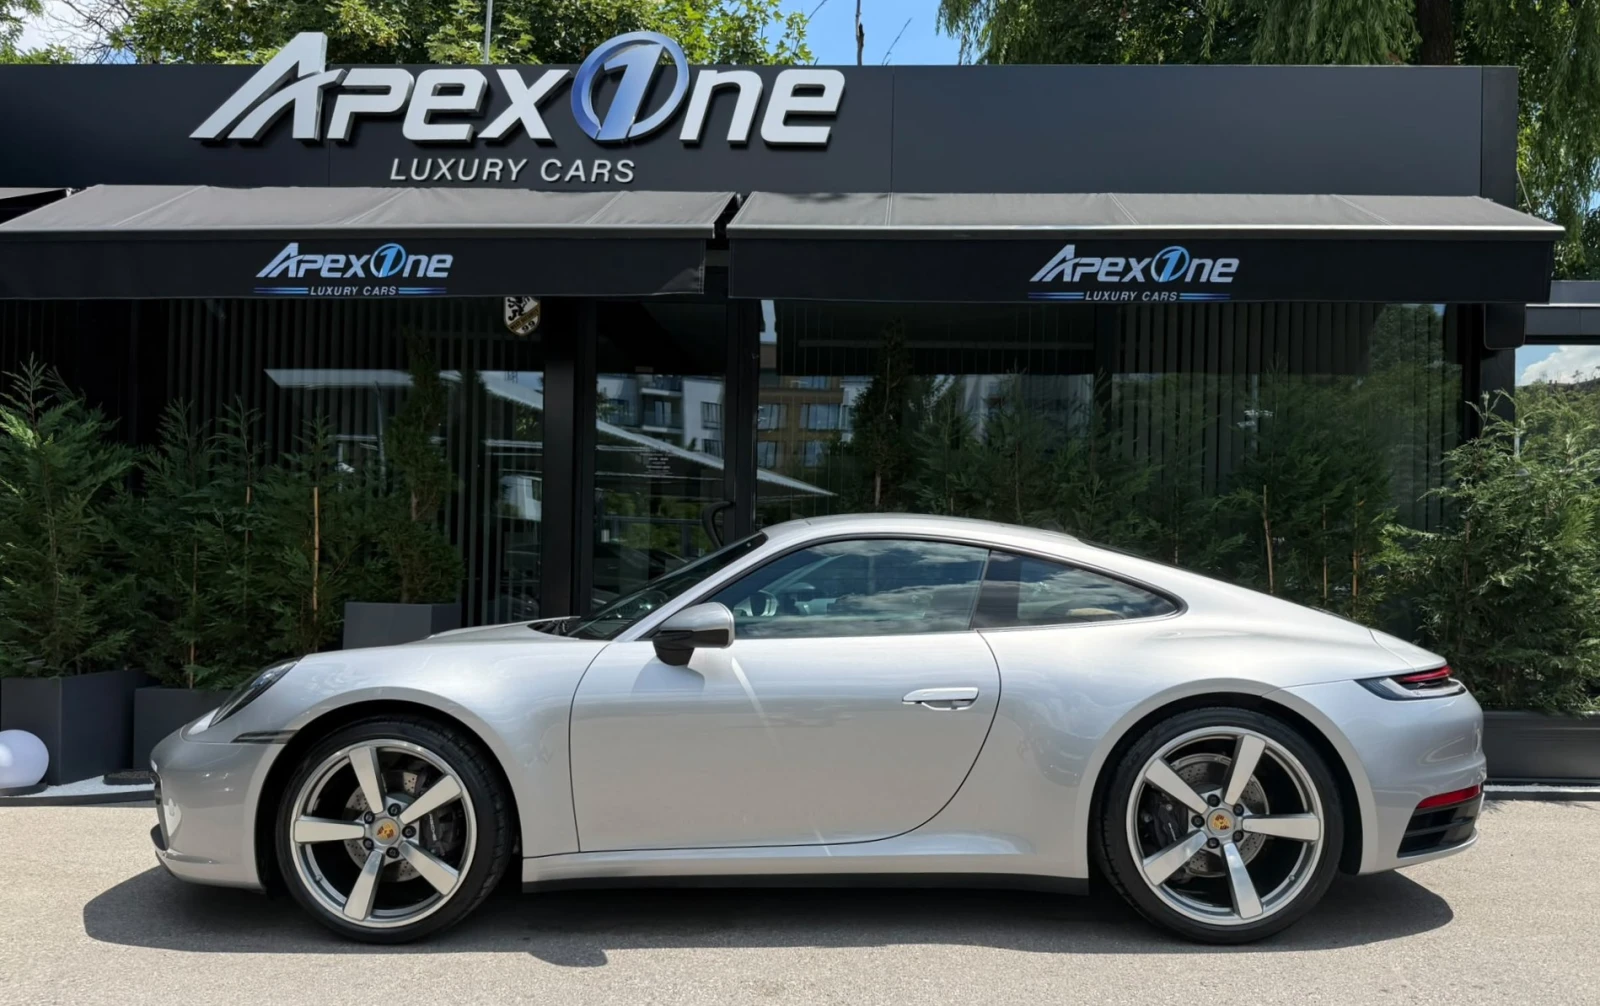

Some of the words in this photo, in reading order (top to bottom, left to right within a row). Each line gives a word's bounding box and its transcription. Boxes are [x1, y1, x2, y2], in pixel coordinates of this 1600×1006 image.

[389, 157, 528, 183] LUXURY
[540, 158, 636, 184] CARS
[310, 286, 359, 296] LUXURY
[363, 286, 397, 296] CARS
[1085, 291, 1138, 301] LUXURY
[1142, 291, 1178, 301] CARS
